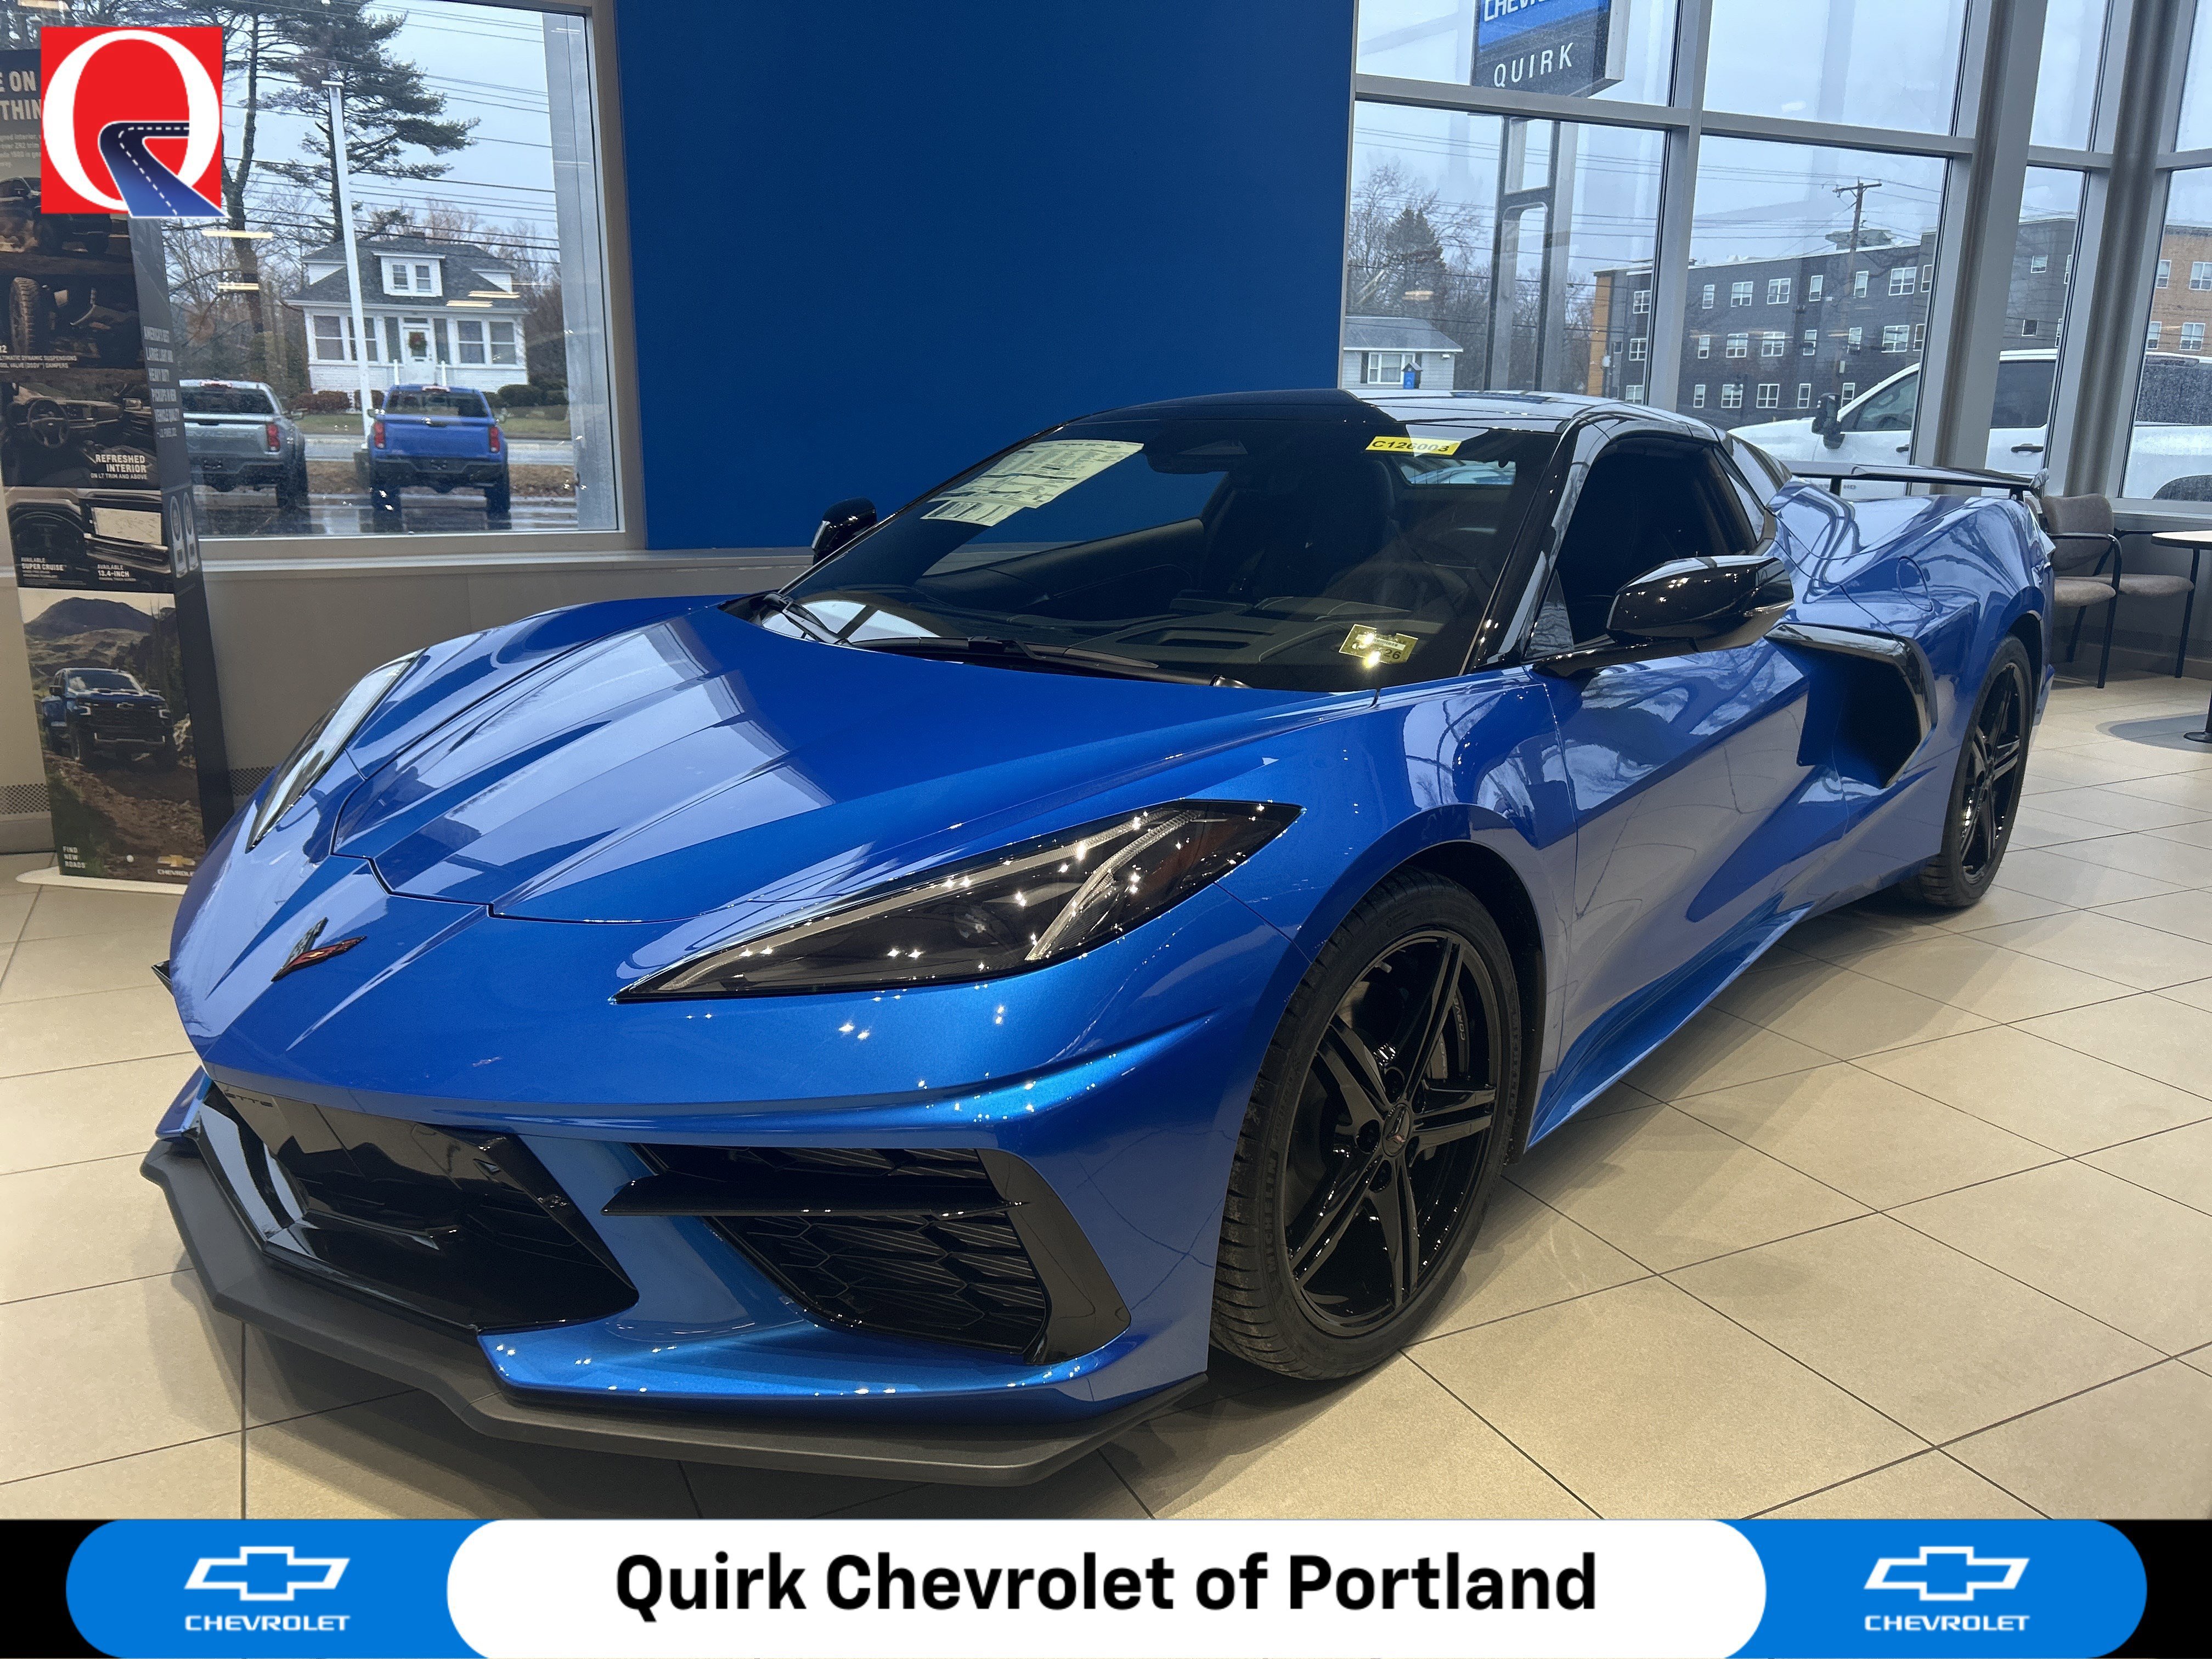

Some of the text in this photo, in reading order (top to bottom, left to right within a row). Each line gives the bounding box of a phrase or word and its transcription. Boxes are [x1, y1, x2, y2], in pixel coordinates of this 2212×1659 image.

[1493, 42, 1574, 88] QUIRK
[9, 71, 37, 92] ON
[1372, 441, 1450, 453] C126003
[95, 454, 145, 464] REFRESHED
[106, 464, 147, 473] INTERIOR
[1384, 648, 1402, 659] 26
[1263, 1159, 1277, 1273] MICHELIN
